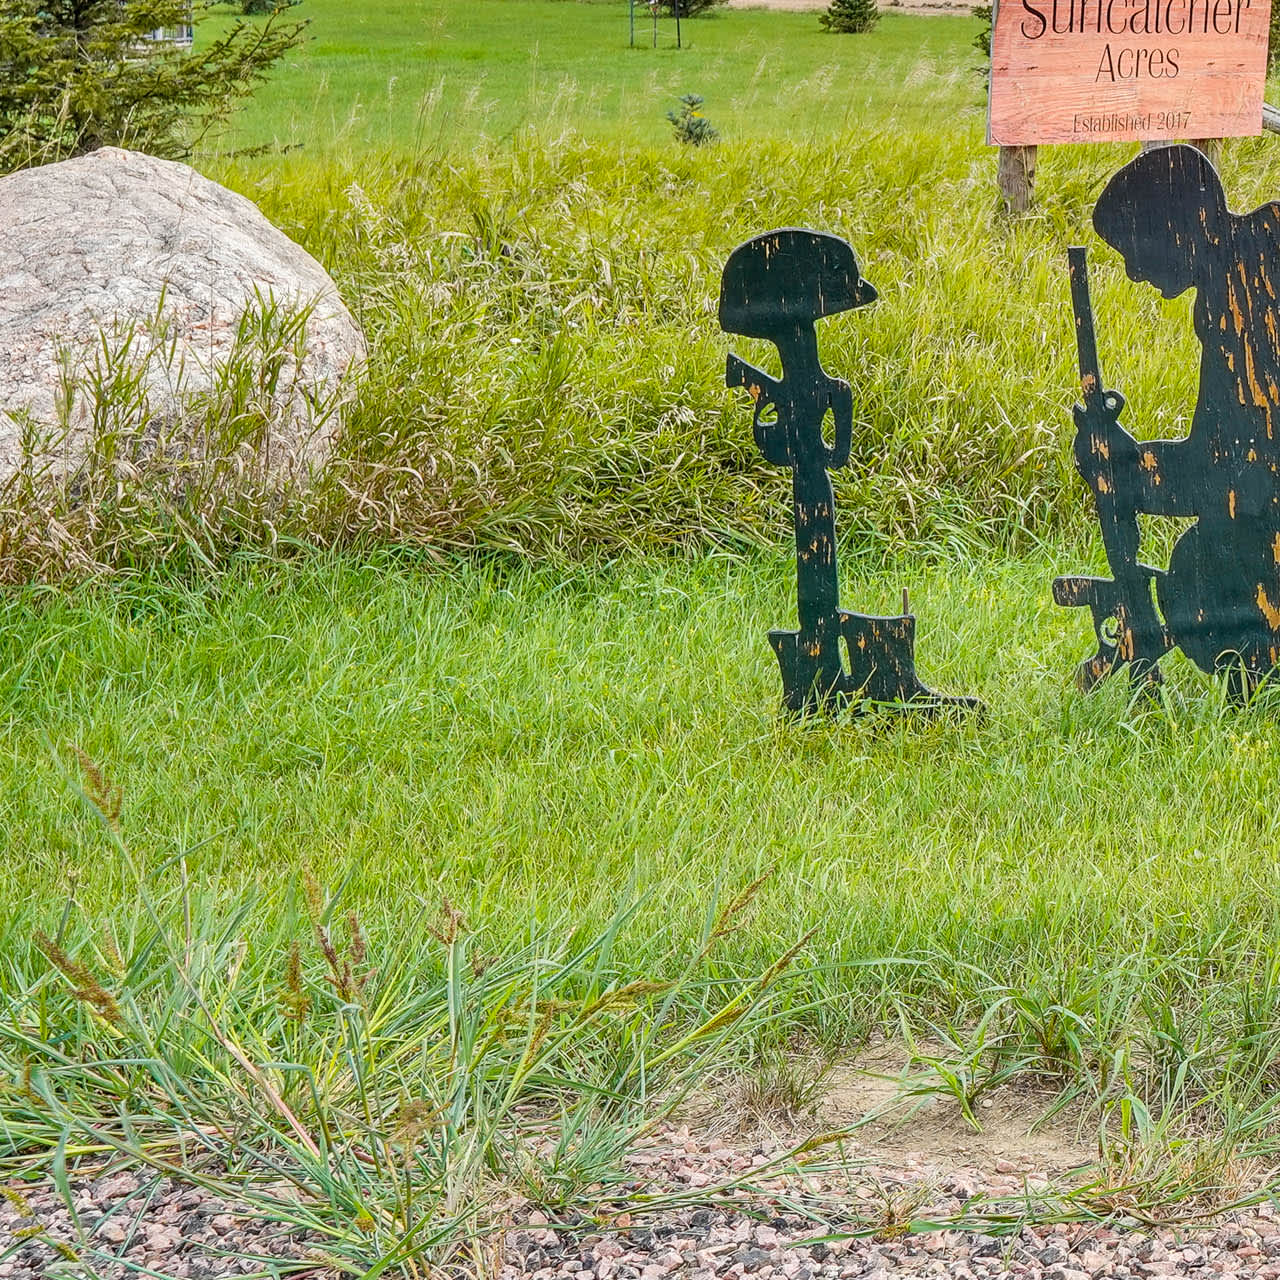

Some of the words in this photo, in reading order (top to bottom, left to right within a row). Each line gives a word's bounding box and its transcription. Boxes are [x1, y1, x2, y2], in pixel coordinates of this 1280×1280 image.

[1095, 43, 1180, 83] Acres
[1073, 112, 1151, 134] Established
[1156, 111, 1192, 131] 2017
